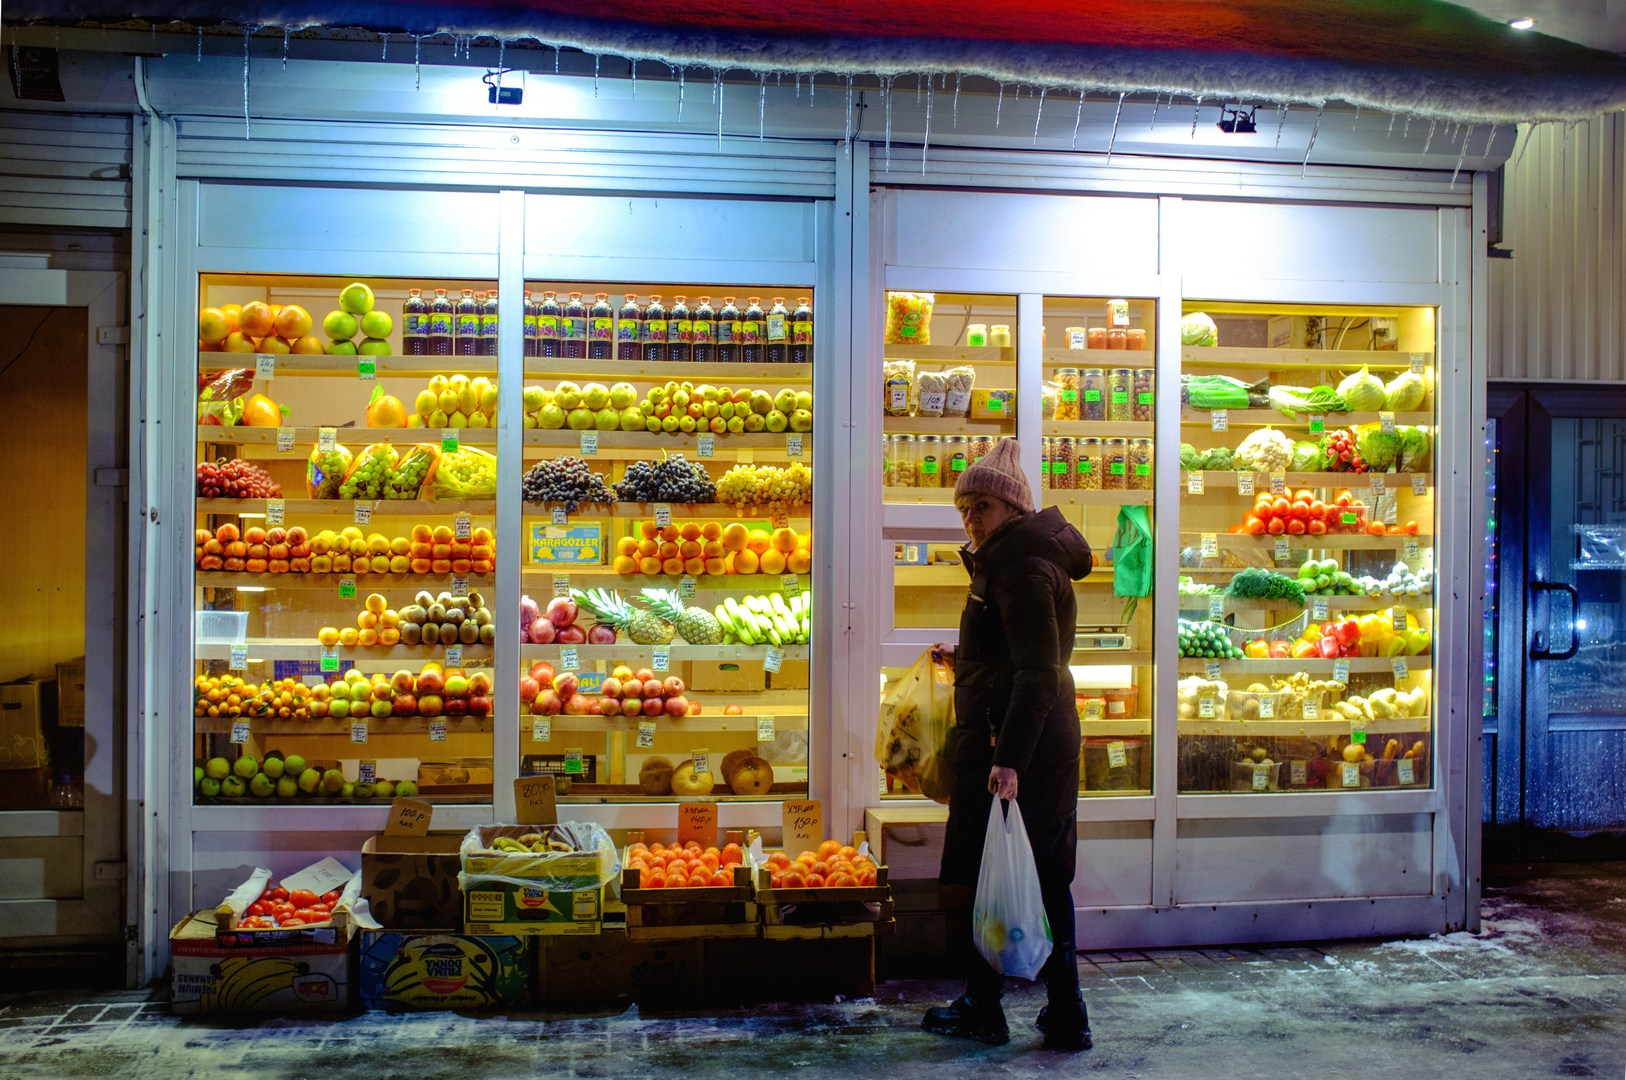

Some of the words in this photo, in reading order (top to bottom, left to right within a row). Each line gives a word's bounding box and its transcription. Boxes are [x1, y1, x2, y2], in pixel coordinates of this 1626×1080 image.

[533, 536, 598, 547] KARAGÖZLER
[425, 959, 462, 968] DONNA
[425, 967, 462, 976] PRIMA
[177, 974, 217, 984] BANANAS
[177, 984, 217, 994] PREMIUM
[298, 981, 329, 998] Dole
